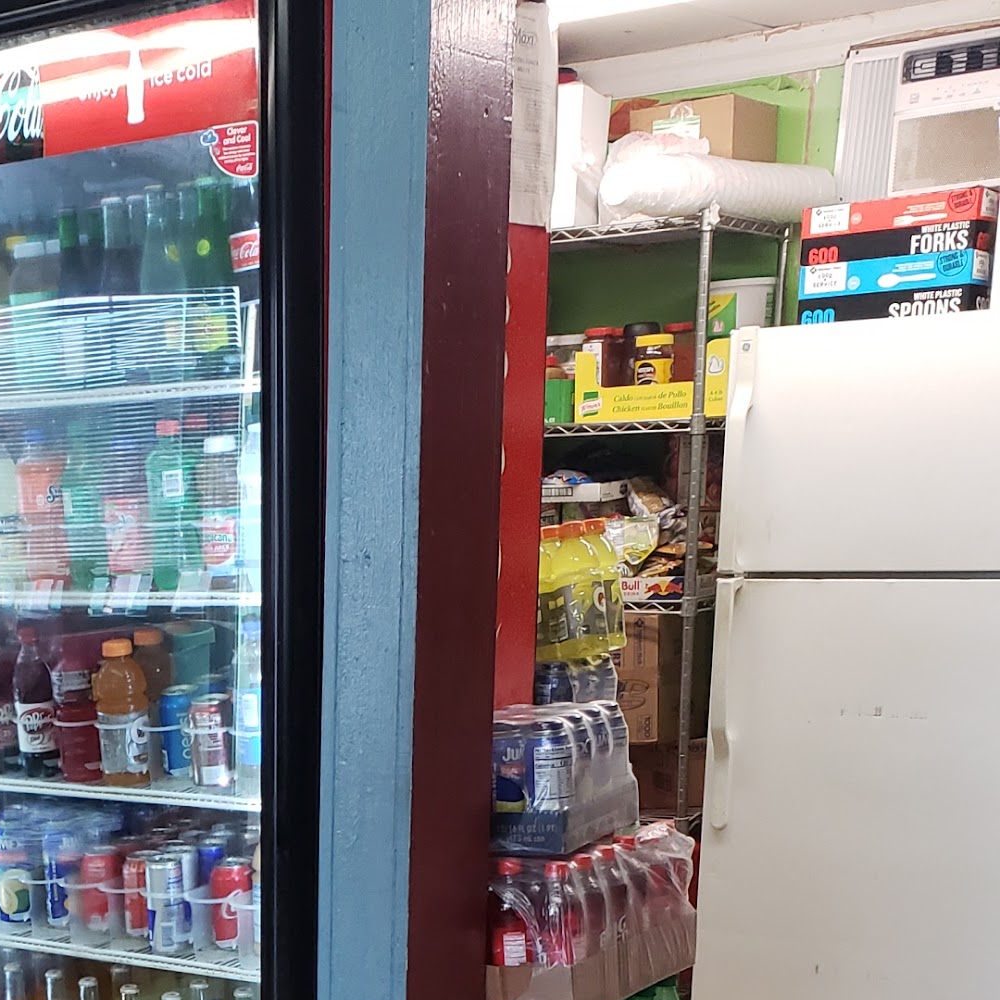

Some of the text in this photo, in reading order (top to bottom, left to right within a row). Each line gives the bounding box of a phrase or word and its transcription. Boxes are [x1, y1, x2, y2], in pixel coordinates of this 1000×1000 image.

[176, 60, 213, 80] cold
[222, 135, 236, 146] and
[921, 220, 971, 233] WHITE PLASTIC
[910, 229, 969, 255] FORKS
[808, 246, 839, 265] 600
[913, 288, 962, 300] WHITE PLASTIC
[888, 298, 961, 318] SPOONS
[801, 308, 835, 325] 600
[614, 394, 634, 402] Caldo
[658, 391, 667, 399] de
[668, 390, 687, 398] Pollo
[612, 405, 640, 413] Chicken
[657, 402, 688, 410] Bouillon
[621, 580, 640, 591] Bull
